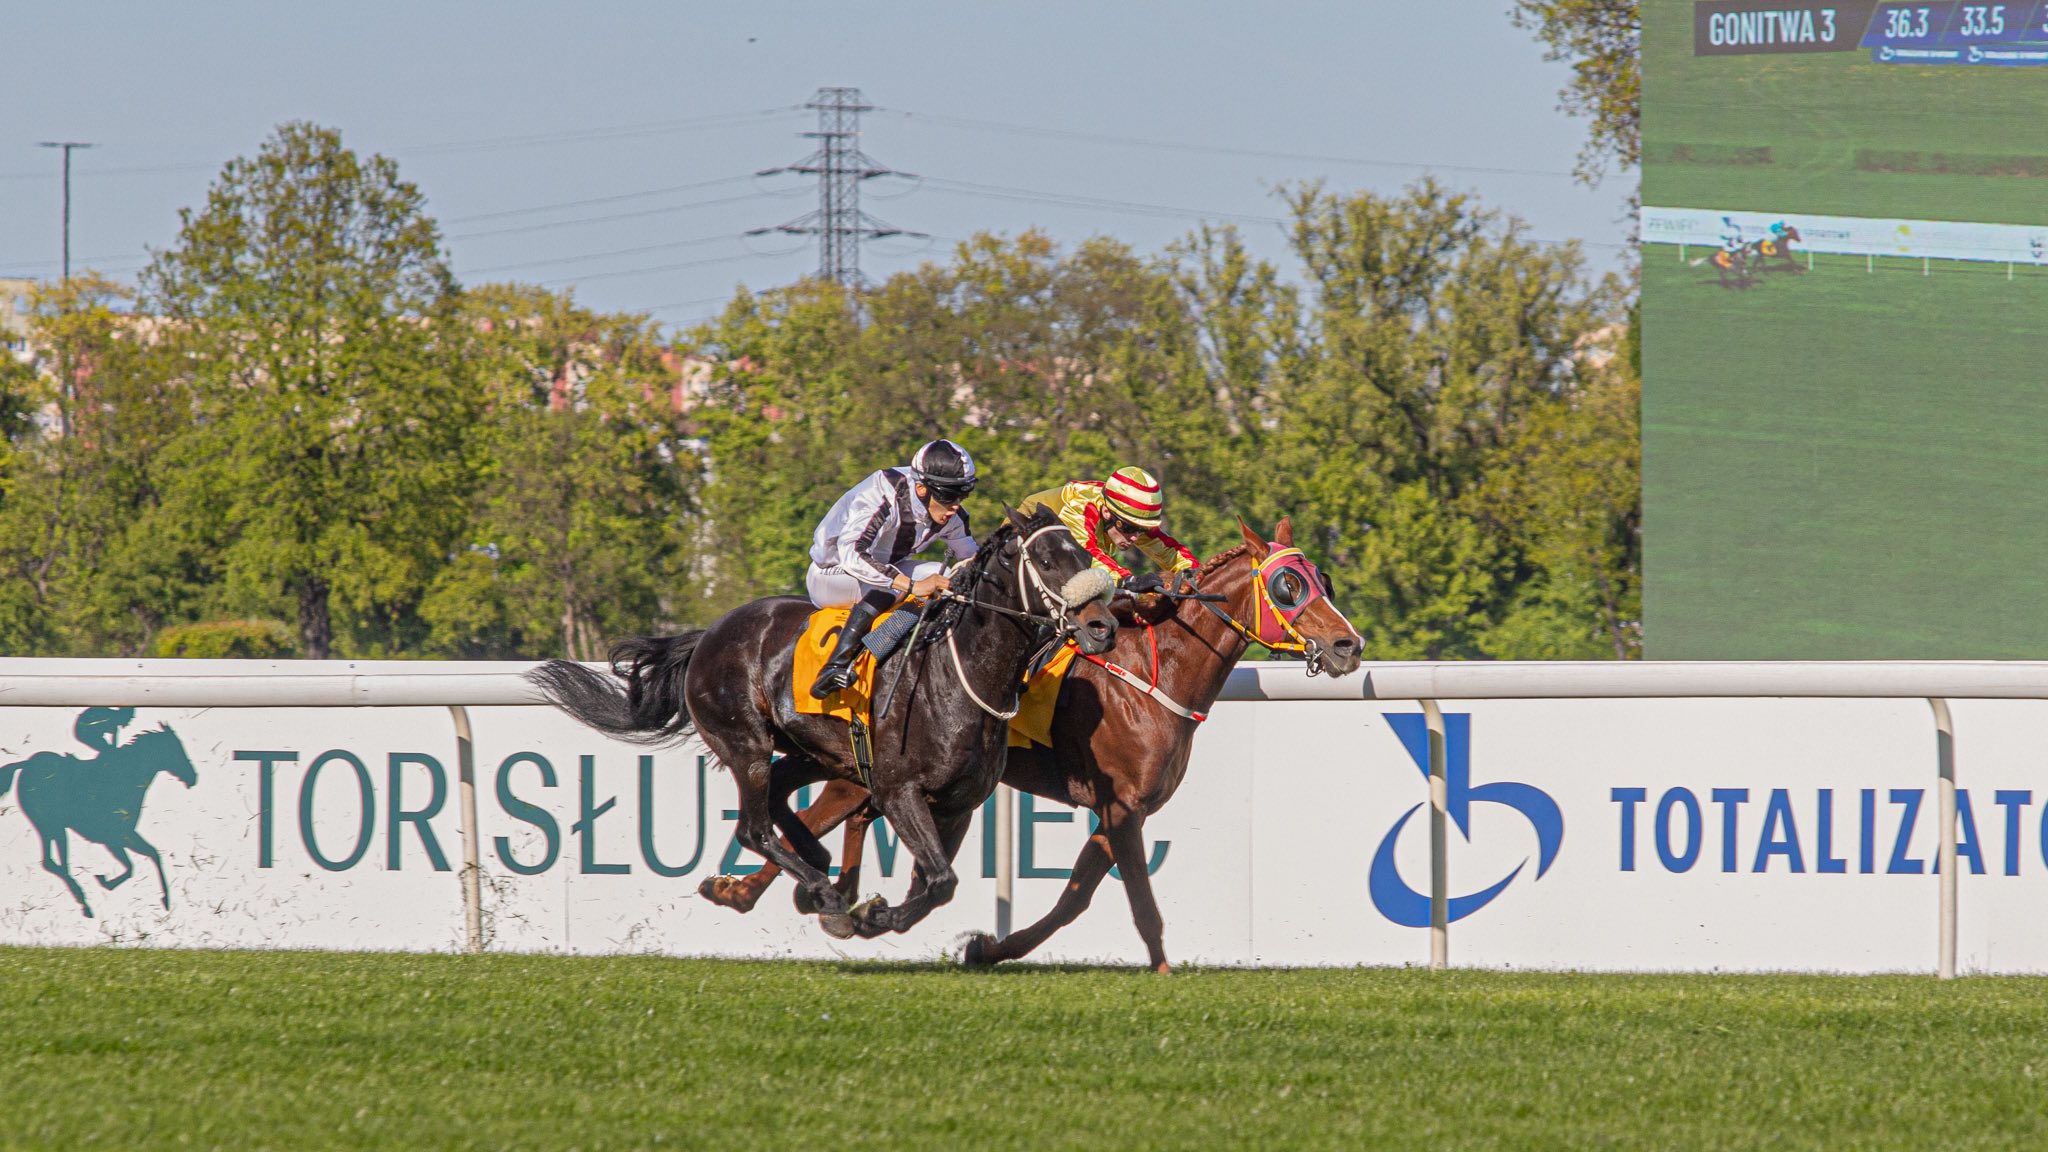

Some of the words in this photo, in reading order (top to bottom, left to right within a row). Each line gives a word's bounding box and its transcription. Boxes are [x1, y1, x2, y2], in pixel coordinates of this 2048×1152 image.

[1709, 10, 1816, 46] GONITWA
[1820, 9, 1837, 43] 3
[1885, 8, 1930, 38] 36.3
[1960, 5, 2006, 36] 33.5
[232, 748, 452, 872] TOR
[1611, 786, 2047, 876] TOTALIZAT
